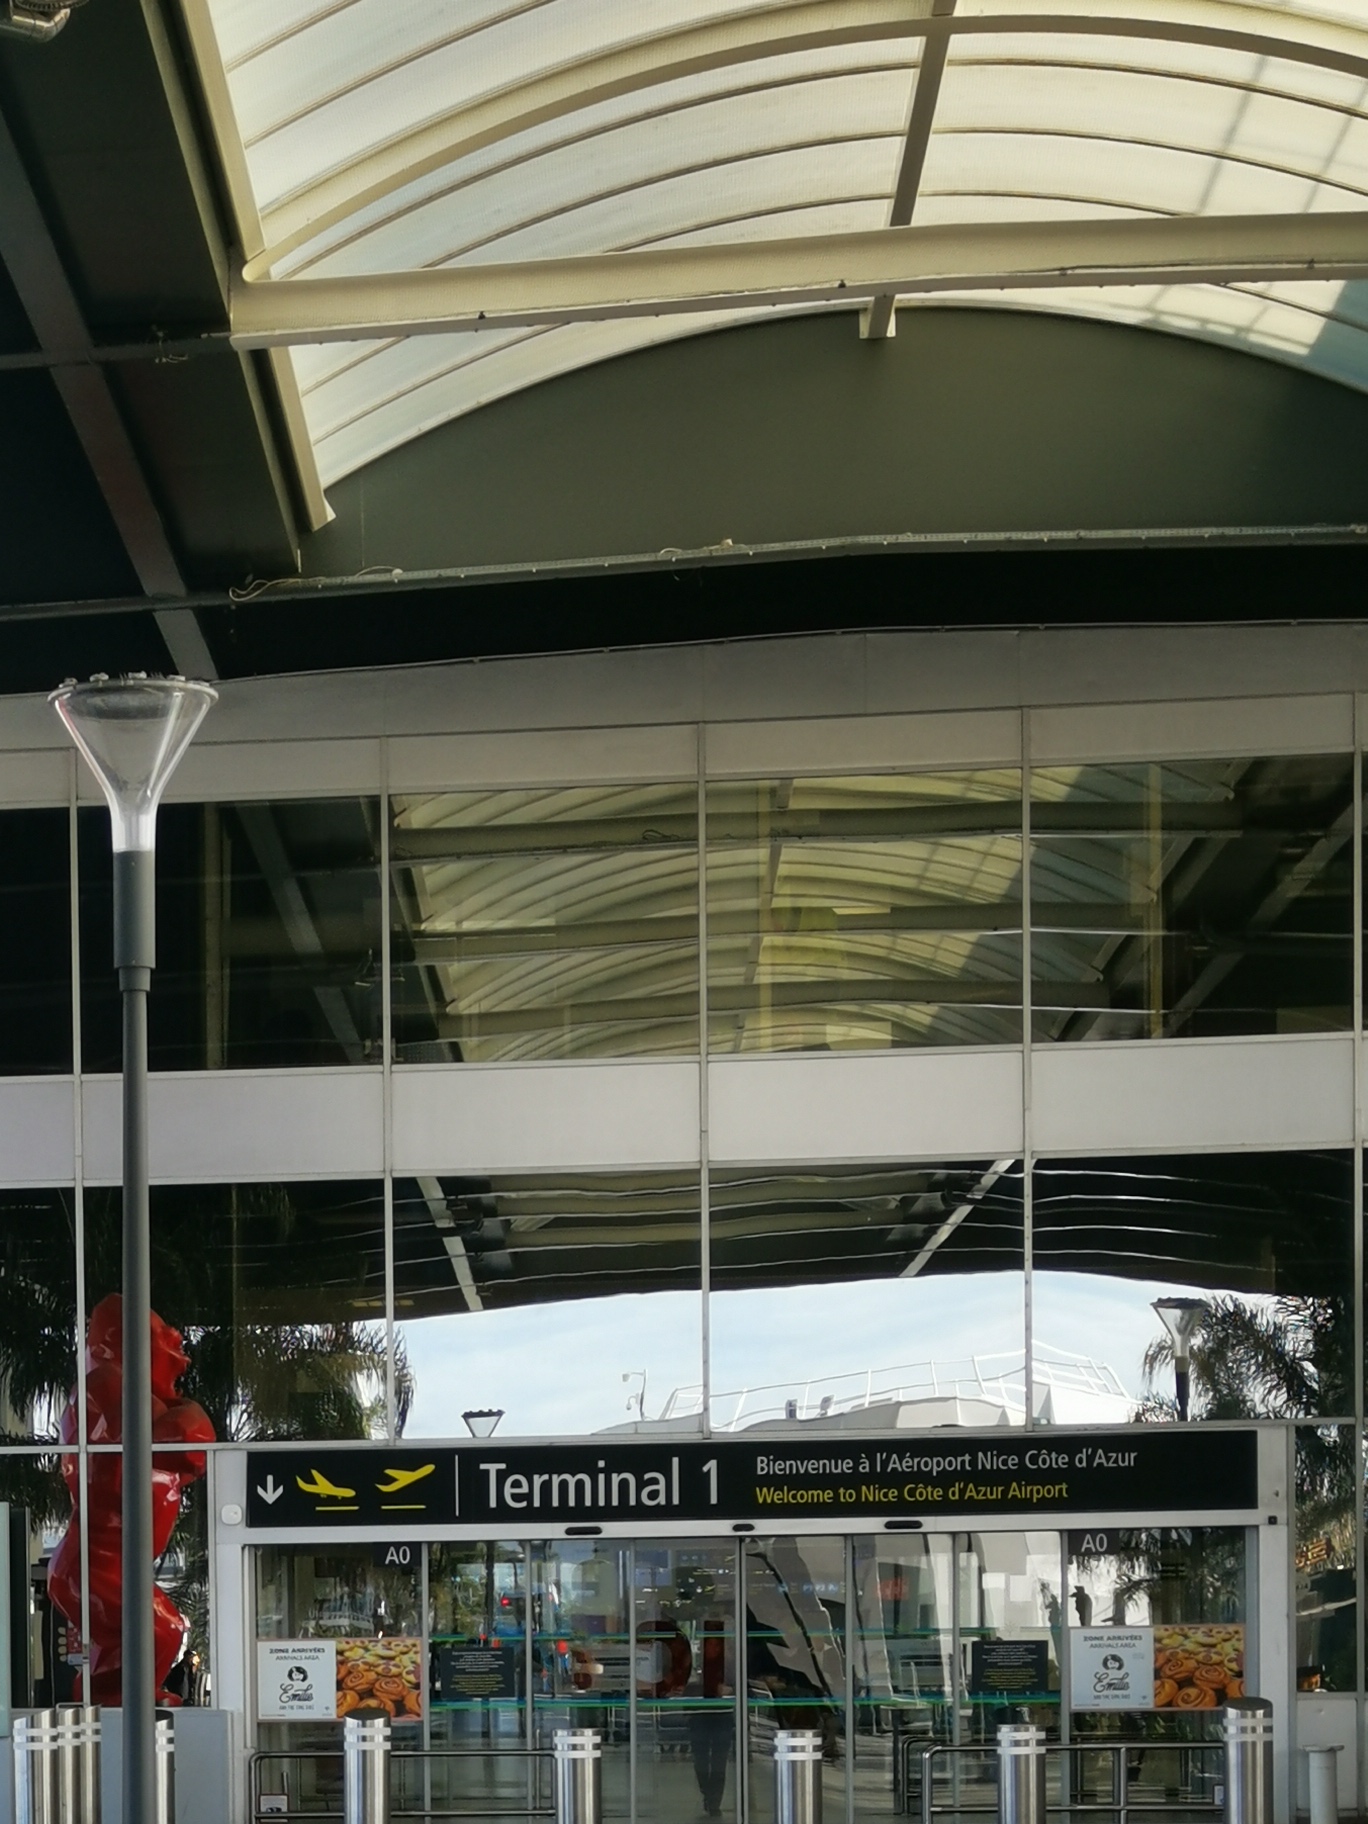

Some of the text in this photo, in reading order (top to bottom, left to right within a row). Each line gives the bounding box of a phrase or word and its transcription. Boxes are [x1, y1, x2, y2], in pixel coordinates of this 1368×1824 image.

[756, 1448, 1138, 1476] Bienvenue à l'Aéroport Nice Côte d'Azur
[479, 1456, 719, 1509] Terminal 1
[755, 1480, 1069, 1504] Welcome to Nice Côte d'Azur Airport
